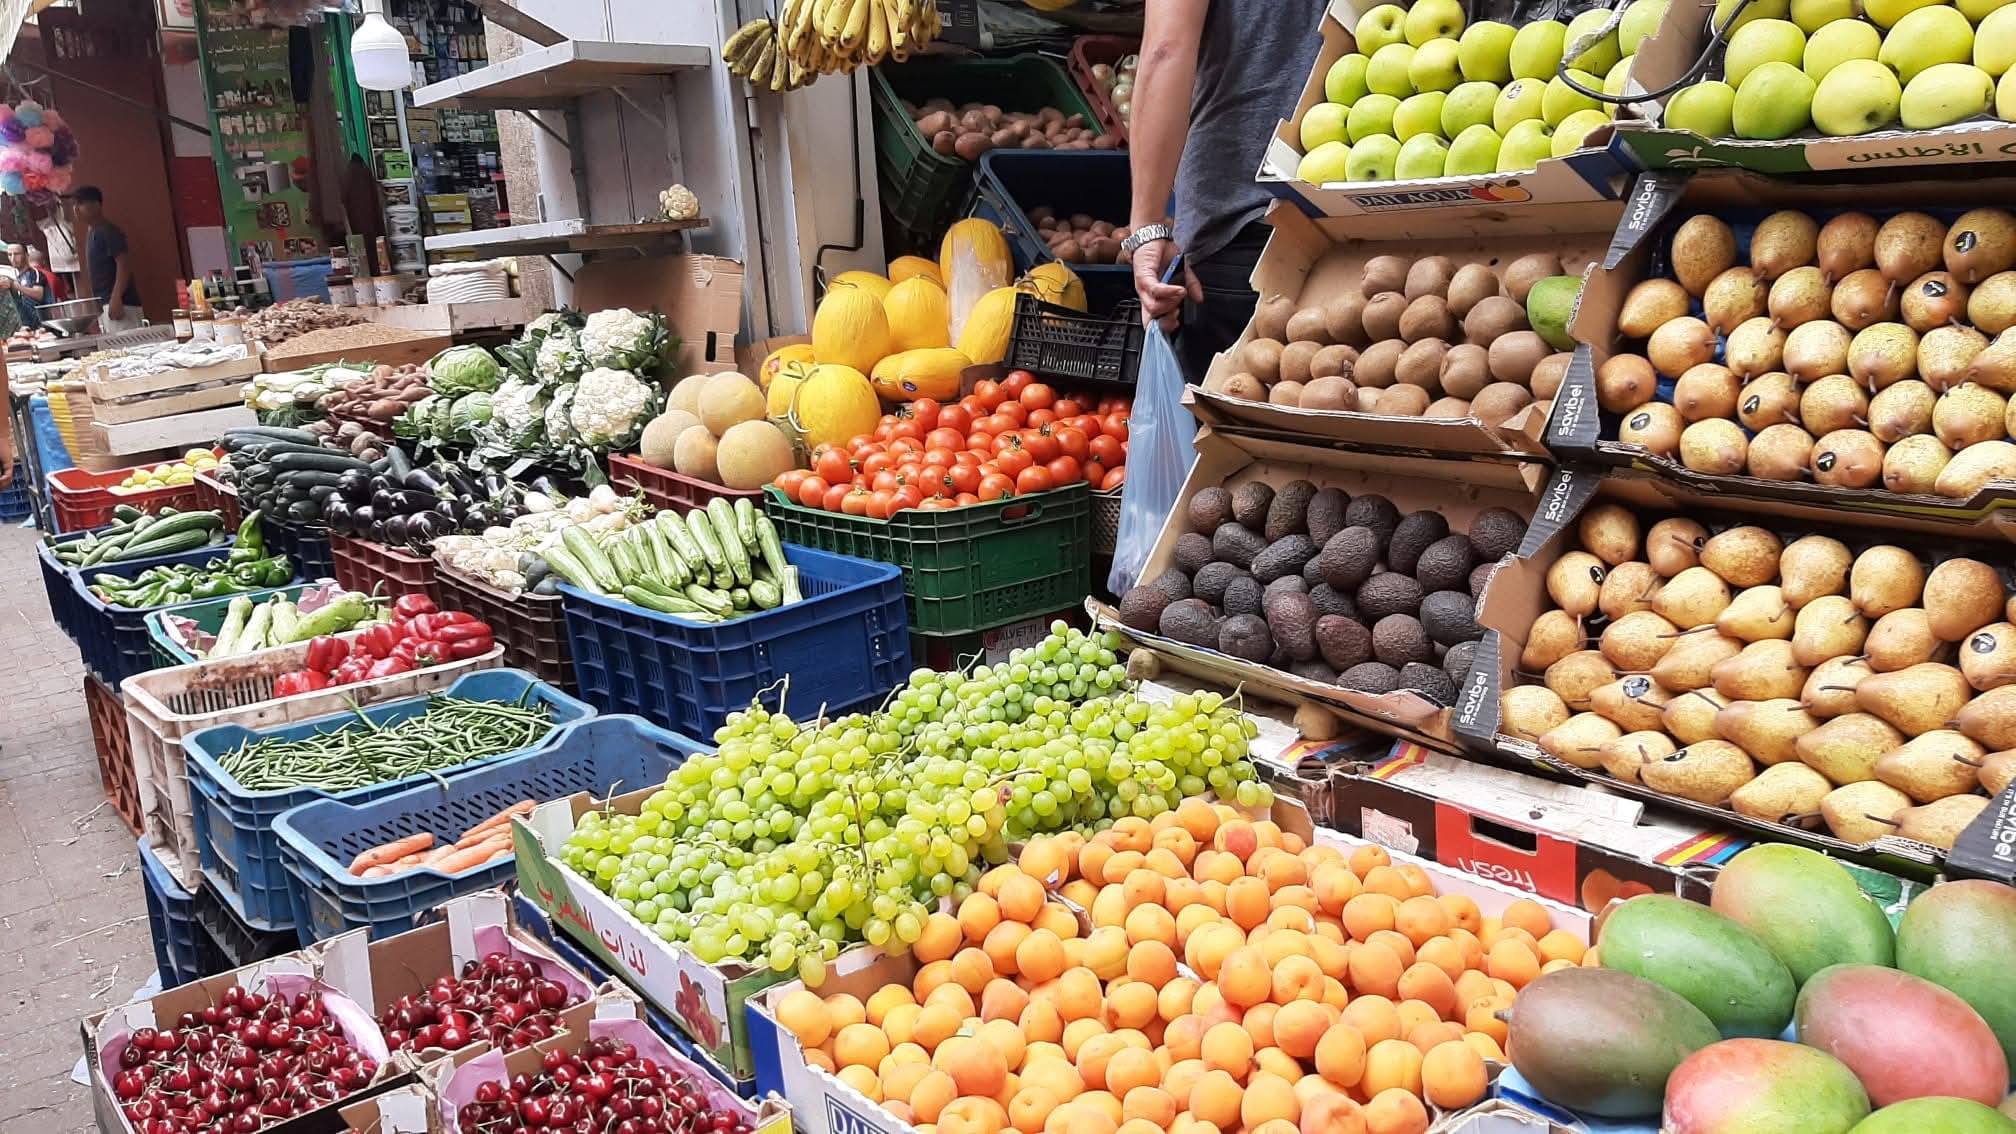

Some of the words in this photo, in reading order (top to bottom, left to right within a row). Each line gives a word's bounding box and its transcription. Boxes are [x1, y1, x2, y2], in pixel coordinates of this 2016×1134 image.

[1847, 142, 1984, 163] الأطلس
[1628, 179, 1657, 230] savibel
[1558, 384, 1583, 436] savibel
[1544, 470, 1573, 520] savibel
[1459, 671, 1488, 724] savibel
